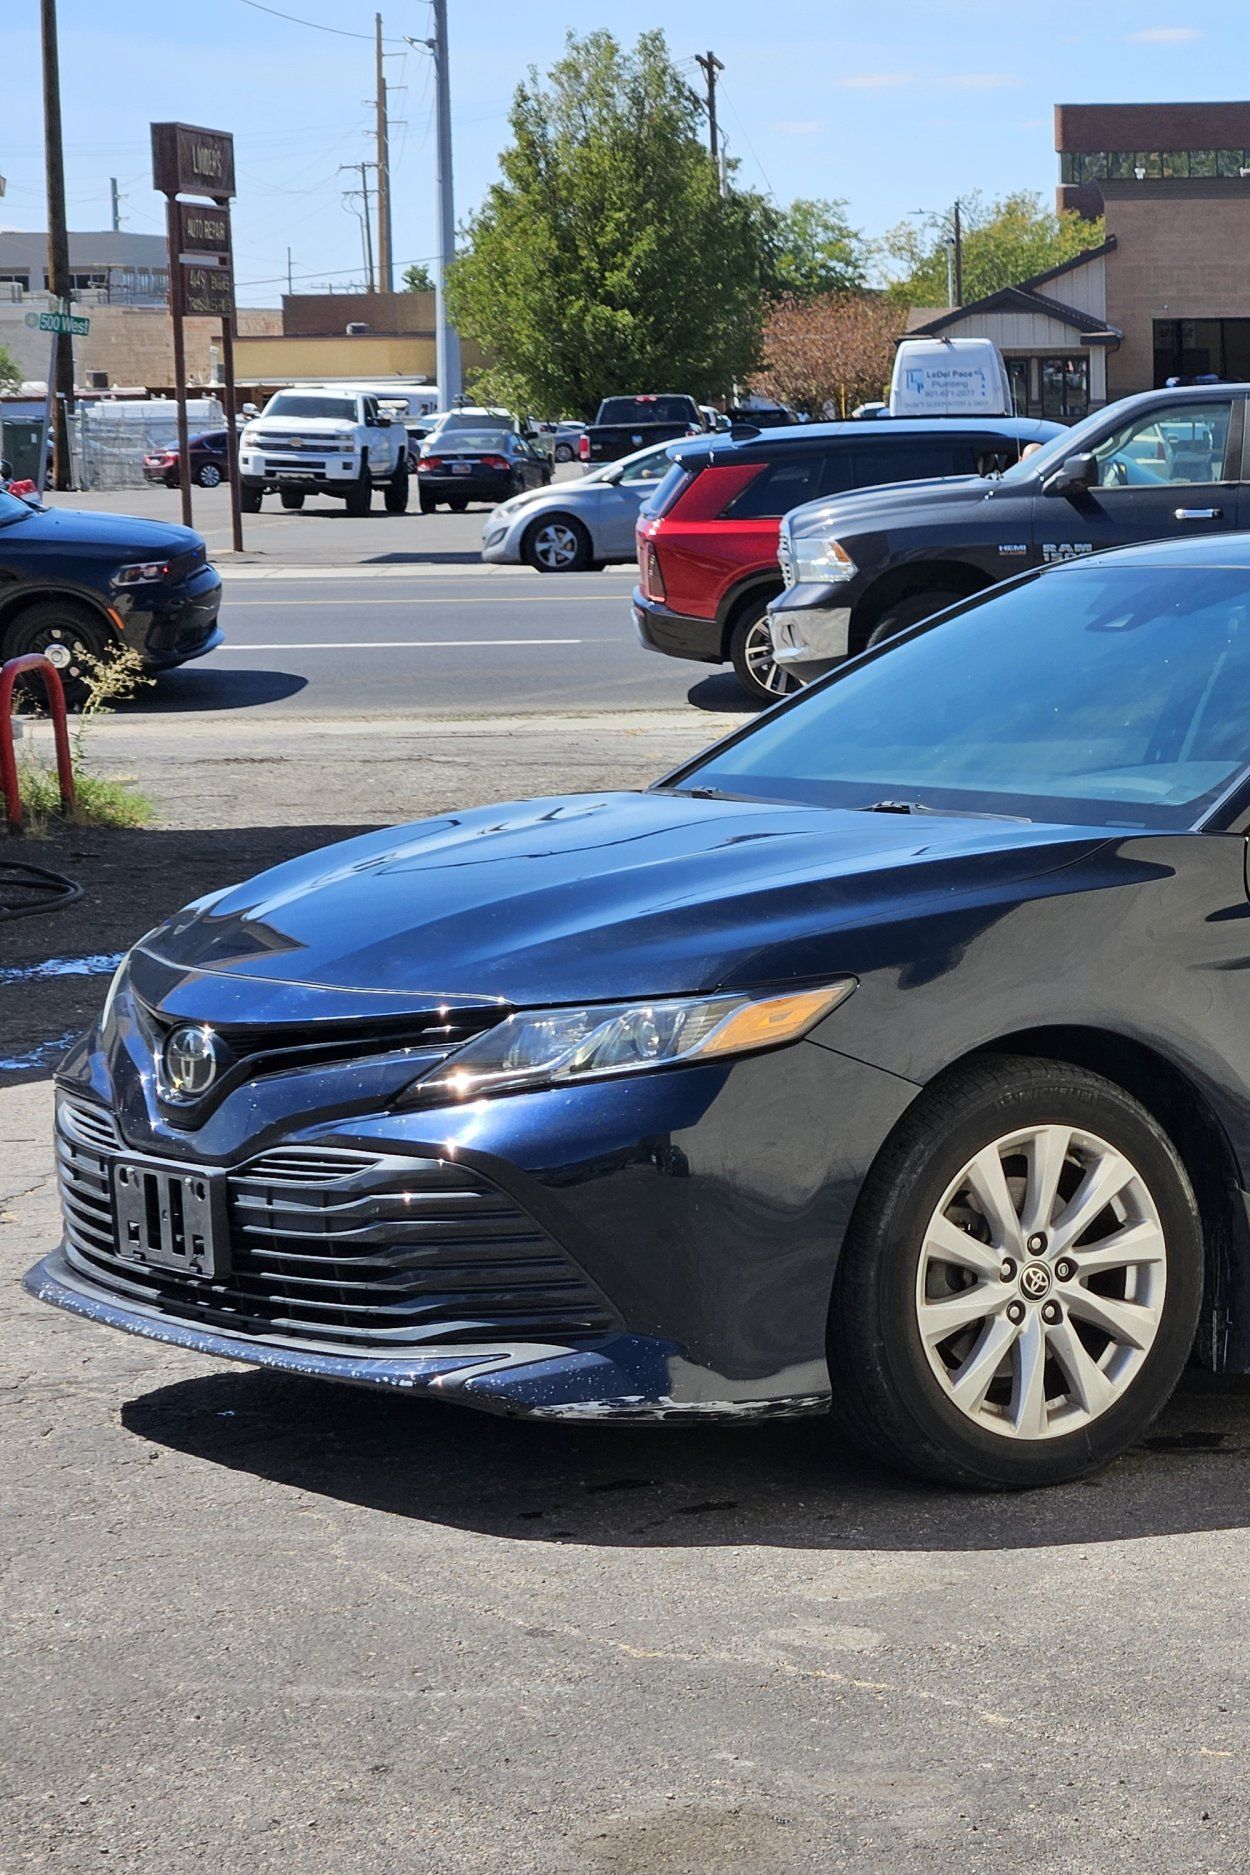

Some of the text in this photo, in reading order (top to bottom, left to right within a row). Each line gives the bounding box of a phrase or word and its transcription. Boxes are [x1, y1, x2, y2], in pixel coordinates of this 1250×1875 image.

[187, 218, 225, 240] AUTO REPAIR
[41, 315, 88, 334] 500 West
[953, 369, 973, 378] Pace
[931, 381, 968, 389] Plumbing
[998, 544, 1026, 552] HEMI
[1043, 543, 1092, 552] RAM
